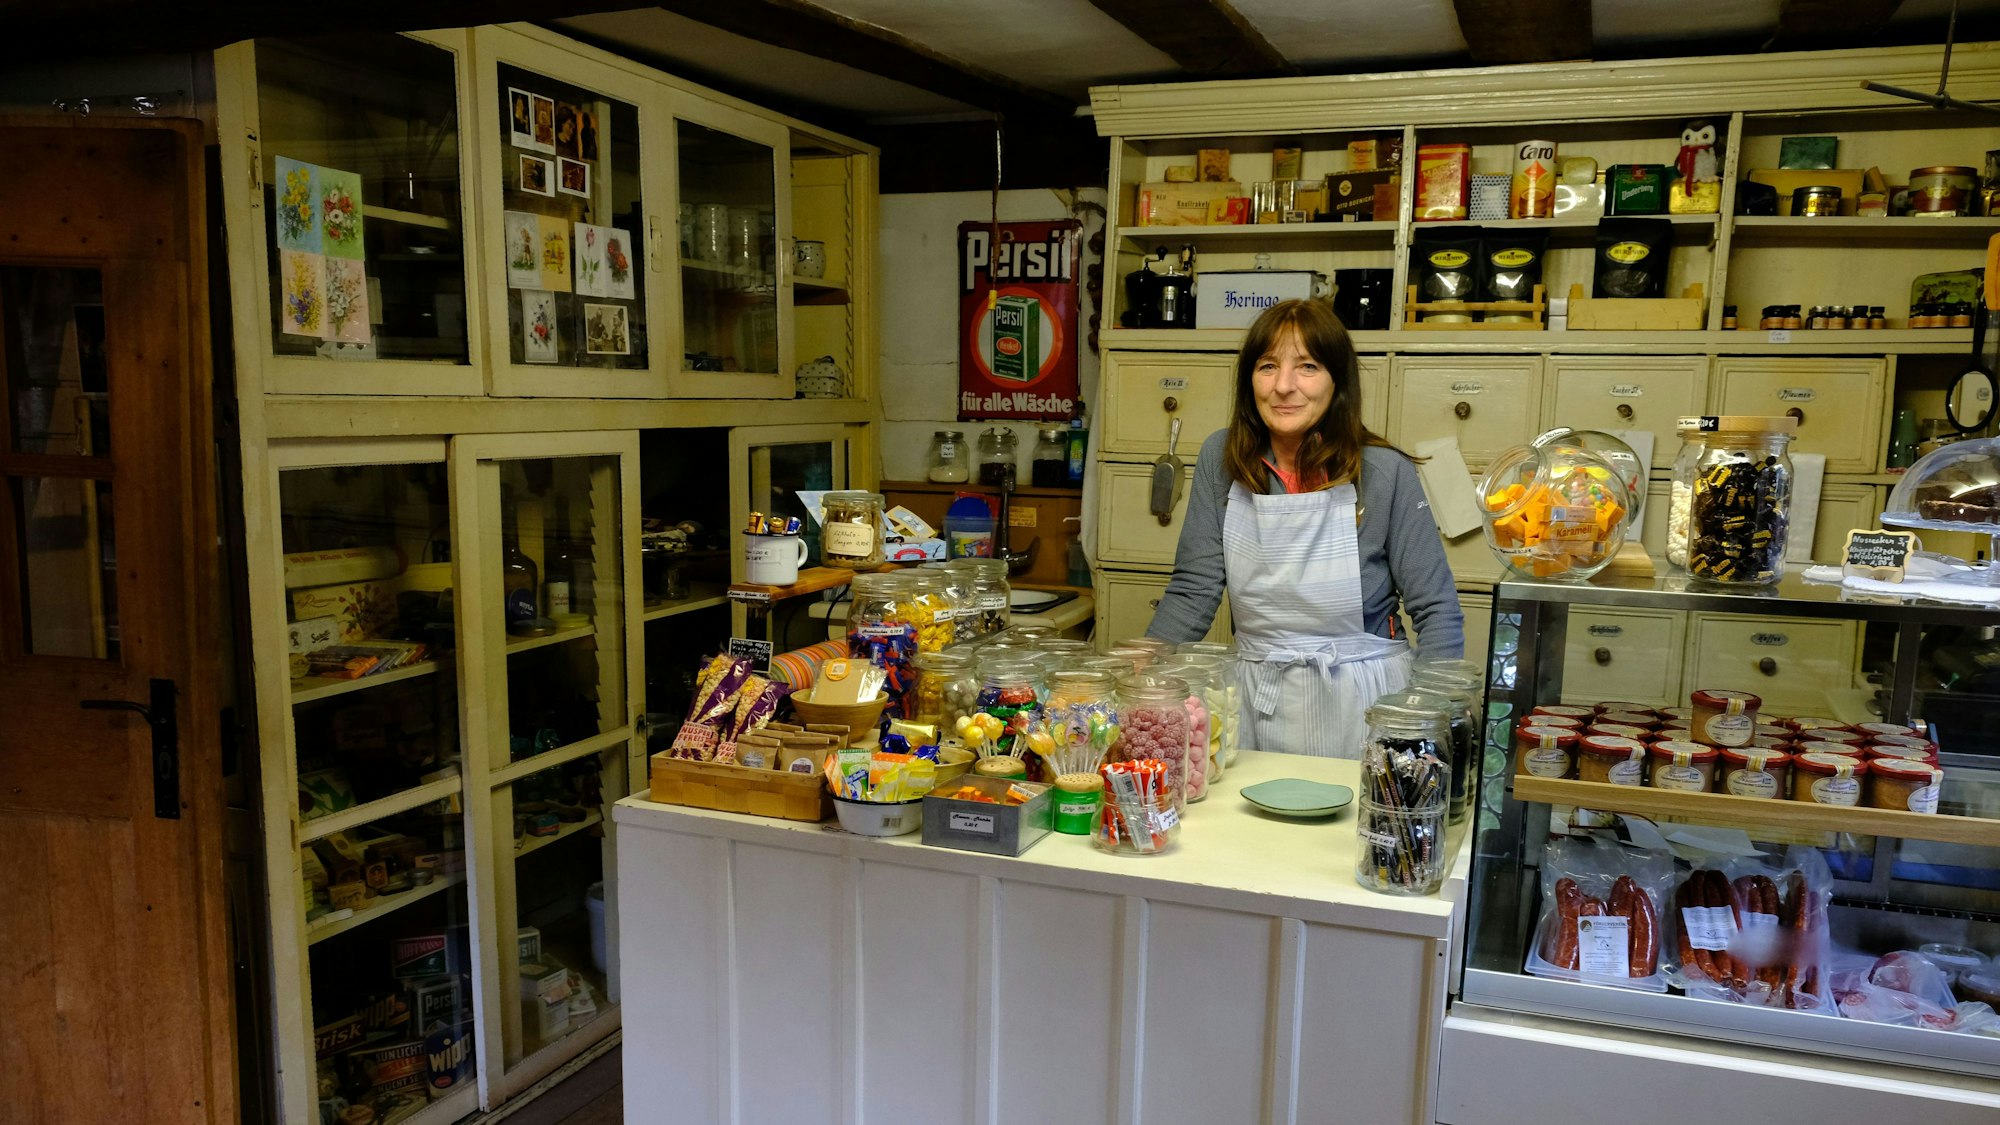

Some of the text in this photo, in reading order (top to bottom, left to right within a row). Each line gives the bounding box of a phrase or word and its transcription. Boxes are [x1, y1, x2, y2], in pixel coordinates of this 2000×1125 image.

[1519, 144, 1553, 160] Caro
[1622, 185, 1654, 200] Underberg
[1336, 202, 1348, 210] OTTO
[966, 229, 1071, 290] Persil
[996, 306, 1022, 327] Persil
[961, 391, 1073, 413] für alle Wäsche
[1557, 526, 1593, 538] Karamell
[1853, 536, 1895, 544] Nussecken
[425, 988, 457, 1014] Persil
[376, 1043, 424, 1063] SUNLICHT
[429, 1032, 471, 1072] wipp
